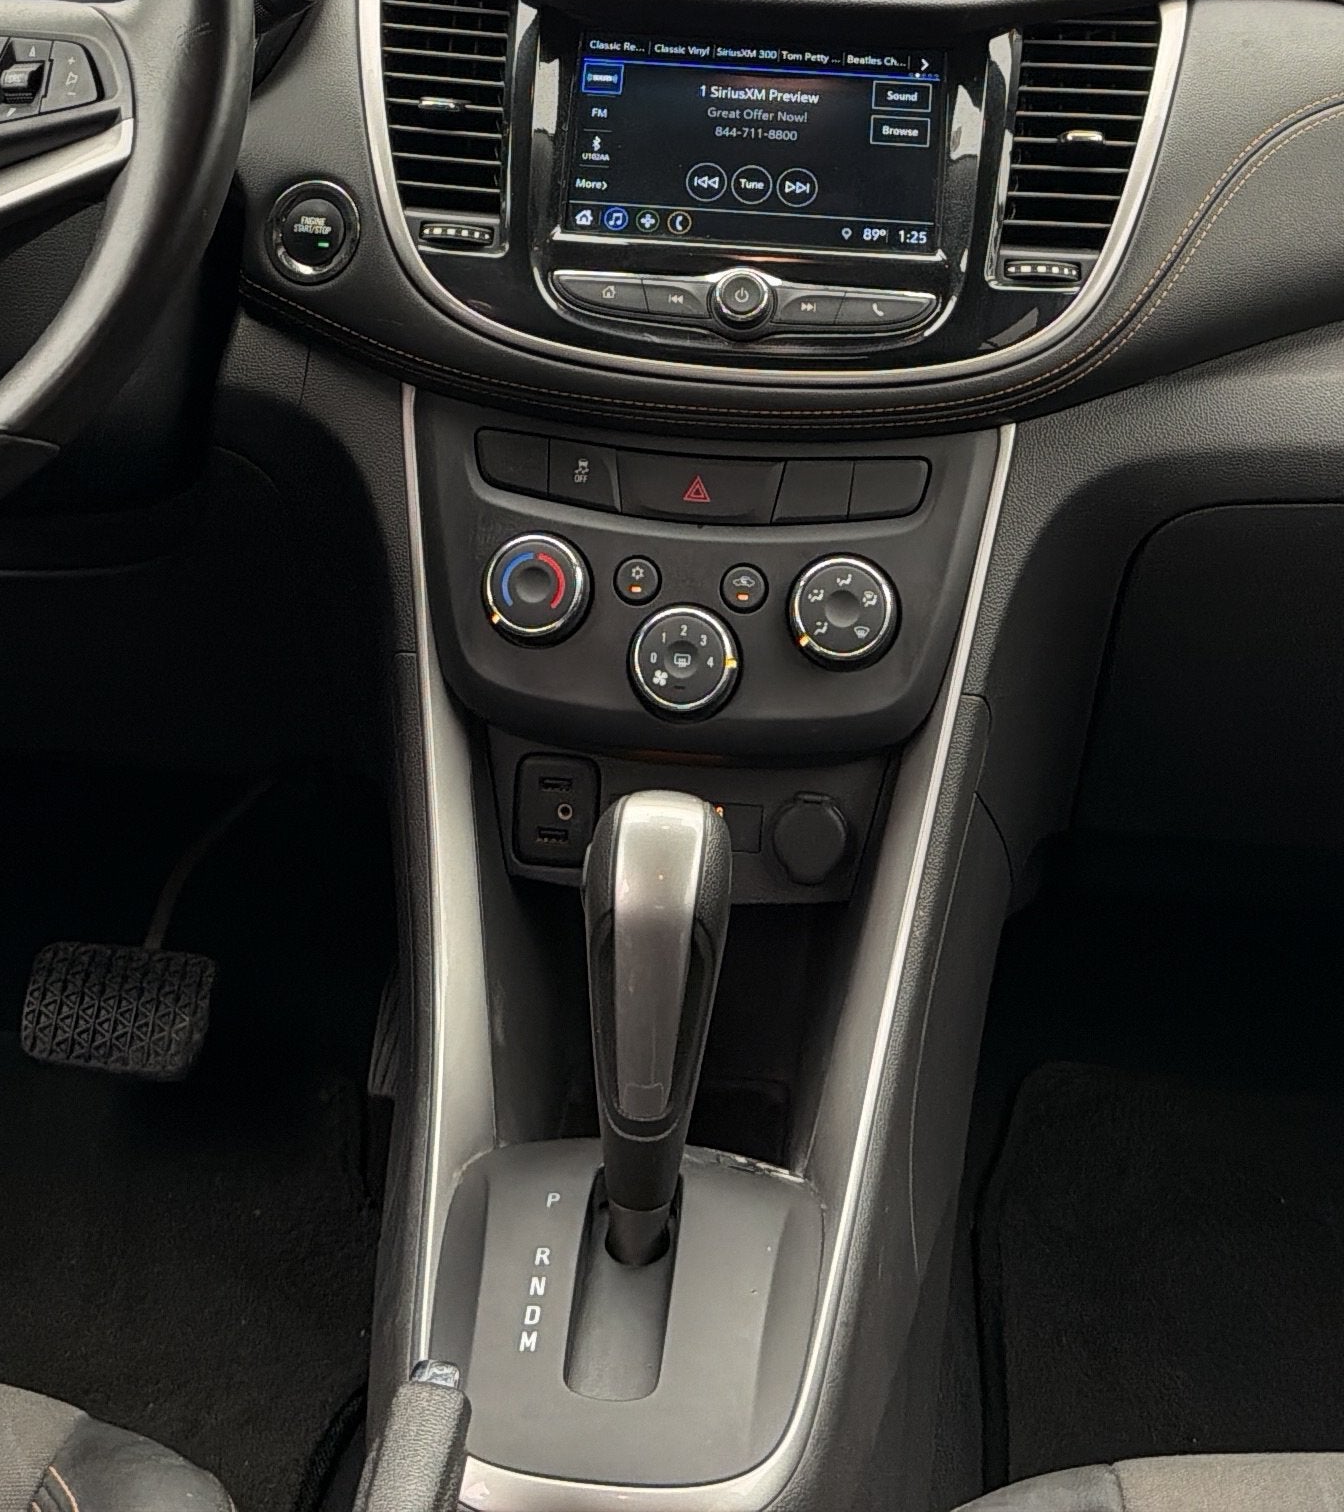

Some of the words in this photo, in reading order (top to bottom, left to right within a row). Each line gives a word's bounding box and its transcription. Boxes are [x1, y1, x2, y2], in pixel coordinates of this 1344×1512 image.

[589, 40, 621, 51] Classic
[654, 43, 686, 55] Classic
[688, 45, 710, 57] Vinyl
[716, 47, 756, 58] SiriusXM
[758, 49, 777, 60] 300
[781, 50, 803, 62] Tom
[804, 52, 829, 65] Petty
[846, 54, 882, 67] Beatles
[710, 85, 766, 101] SiriusXM
[768, 90, 820, 105] Preview
[886, 90, 919, 103] Sound
[591, 107, 608, 119] FM
[707, 106, 741, 120] Great
[743, 108, 774, 122] Offer
[777, 111, 808, 124] Now!
[714, 125, 798, 141] 844-711-8800
[882, 125, 919, 138] Browse
[739, 178, 765, 190] Tune
[300, 215, 327, 227] ENGINE
[293, 224, 332, 235] START/STOP
[898, 229, 927, 244] 1:25
[573, 473, 588, 484] OFF
[680, 624, 688, 637] 2
[700, 634, 708, 646] 3
[706, 656, 715, 669] 4
[545, 1192, 561, 1209] P
[534, 1246, 551, 1266] R
[528, 1277, 546, 1296] N
[524, 1305, 541, 1326] D
[518, 1330, 538, 1353] M
